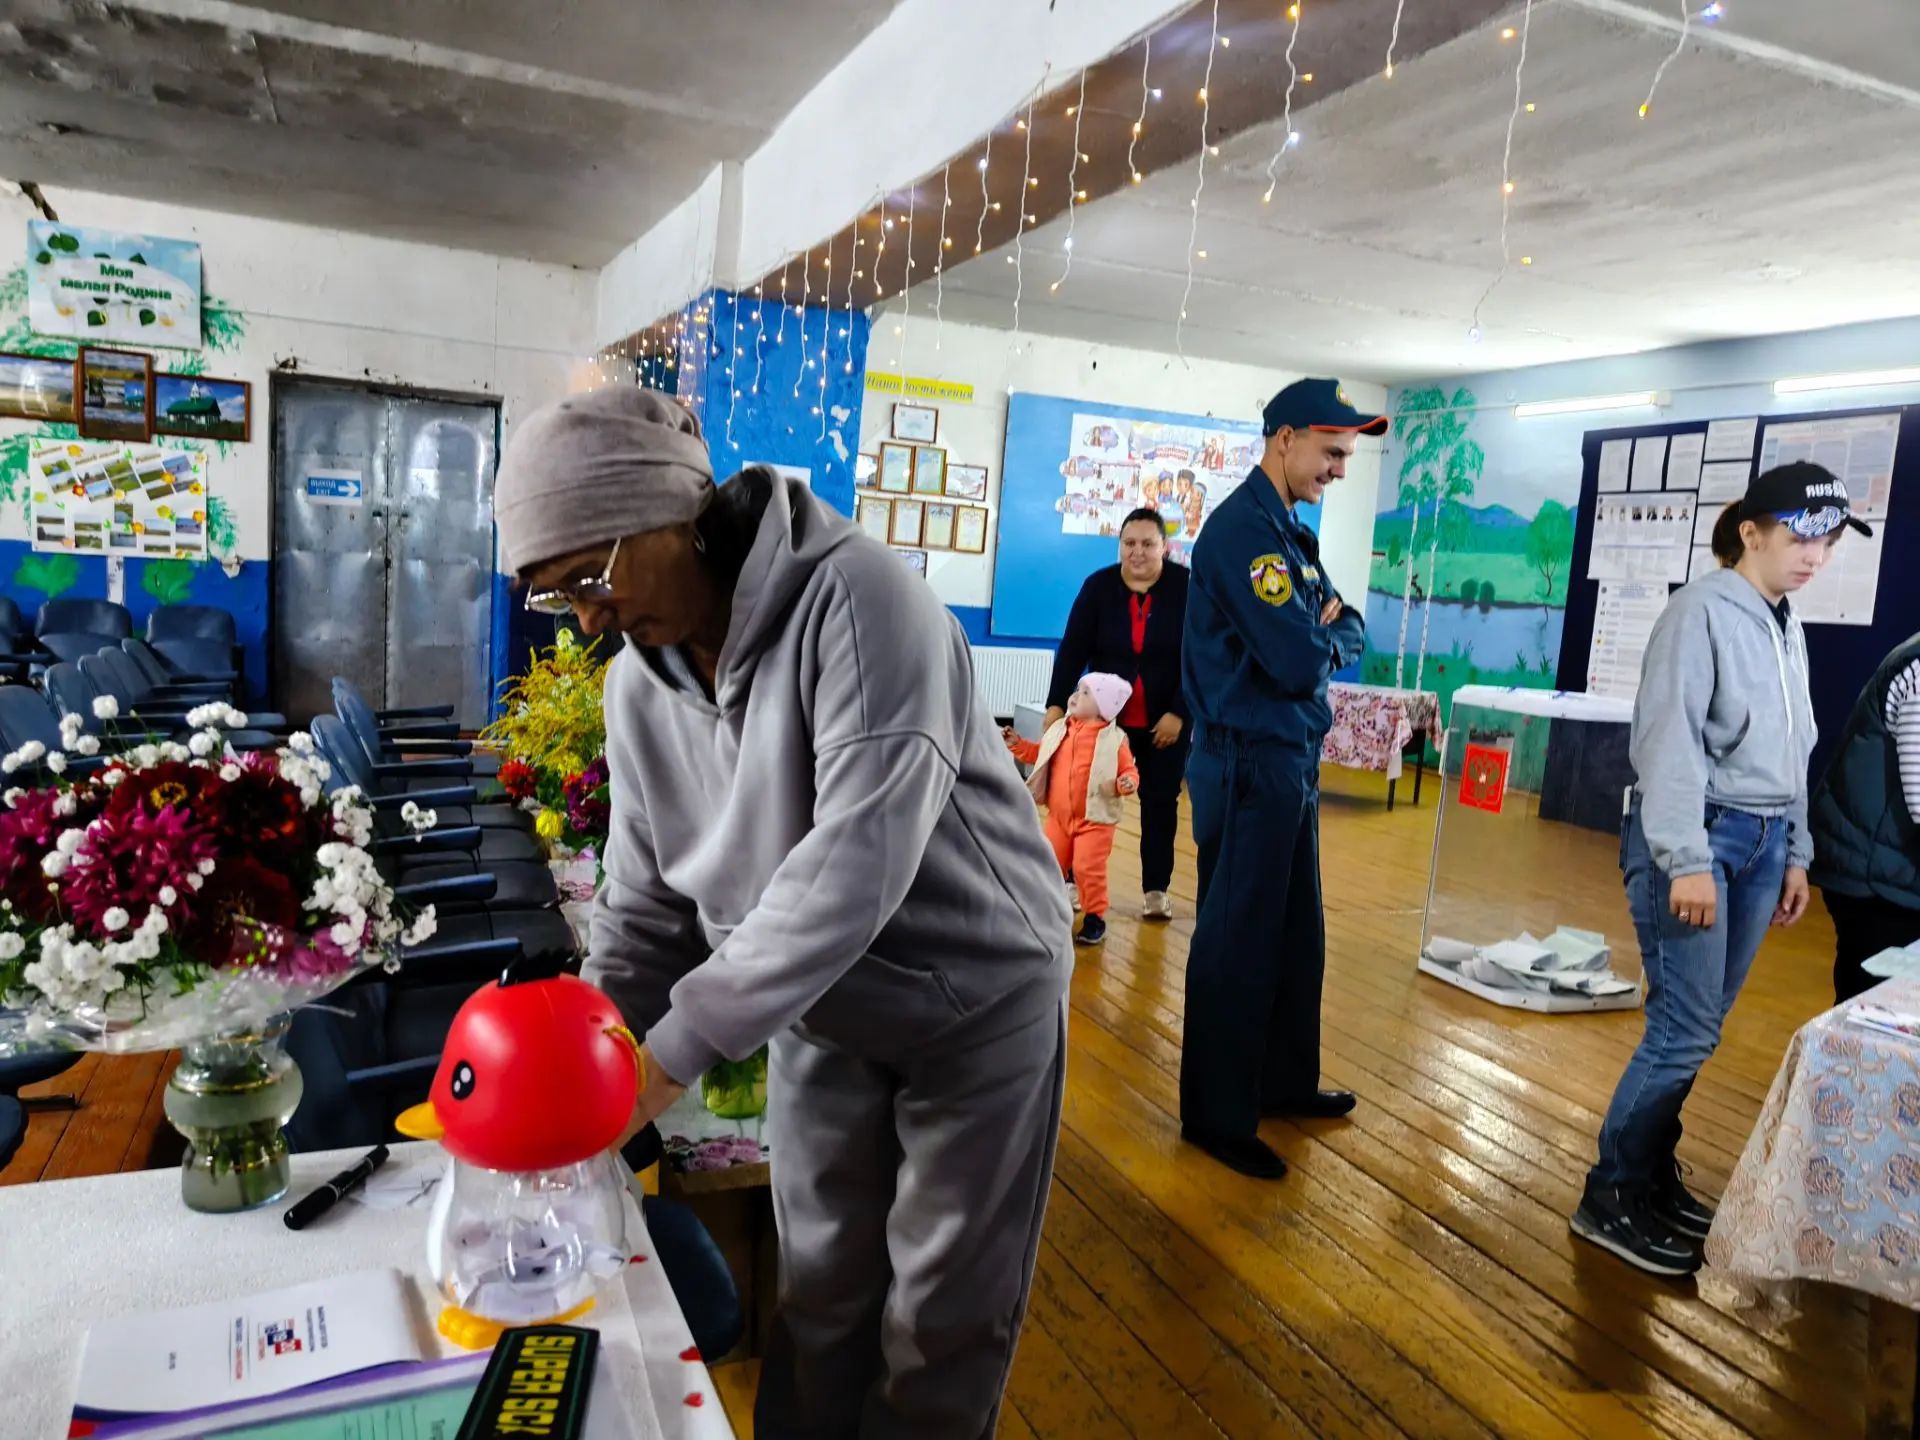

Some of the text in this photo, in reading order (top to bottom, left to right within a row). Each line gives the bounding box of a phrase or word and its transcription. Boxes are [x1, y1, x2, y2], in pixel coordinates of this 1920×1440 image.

[100, 263, 134, 279] Моя
[60, 277, 172, 300] малая Родина
[507, 1335, 577, 1394] SUPER
